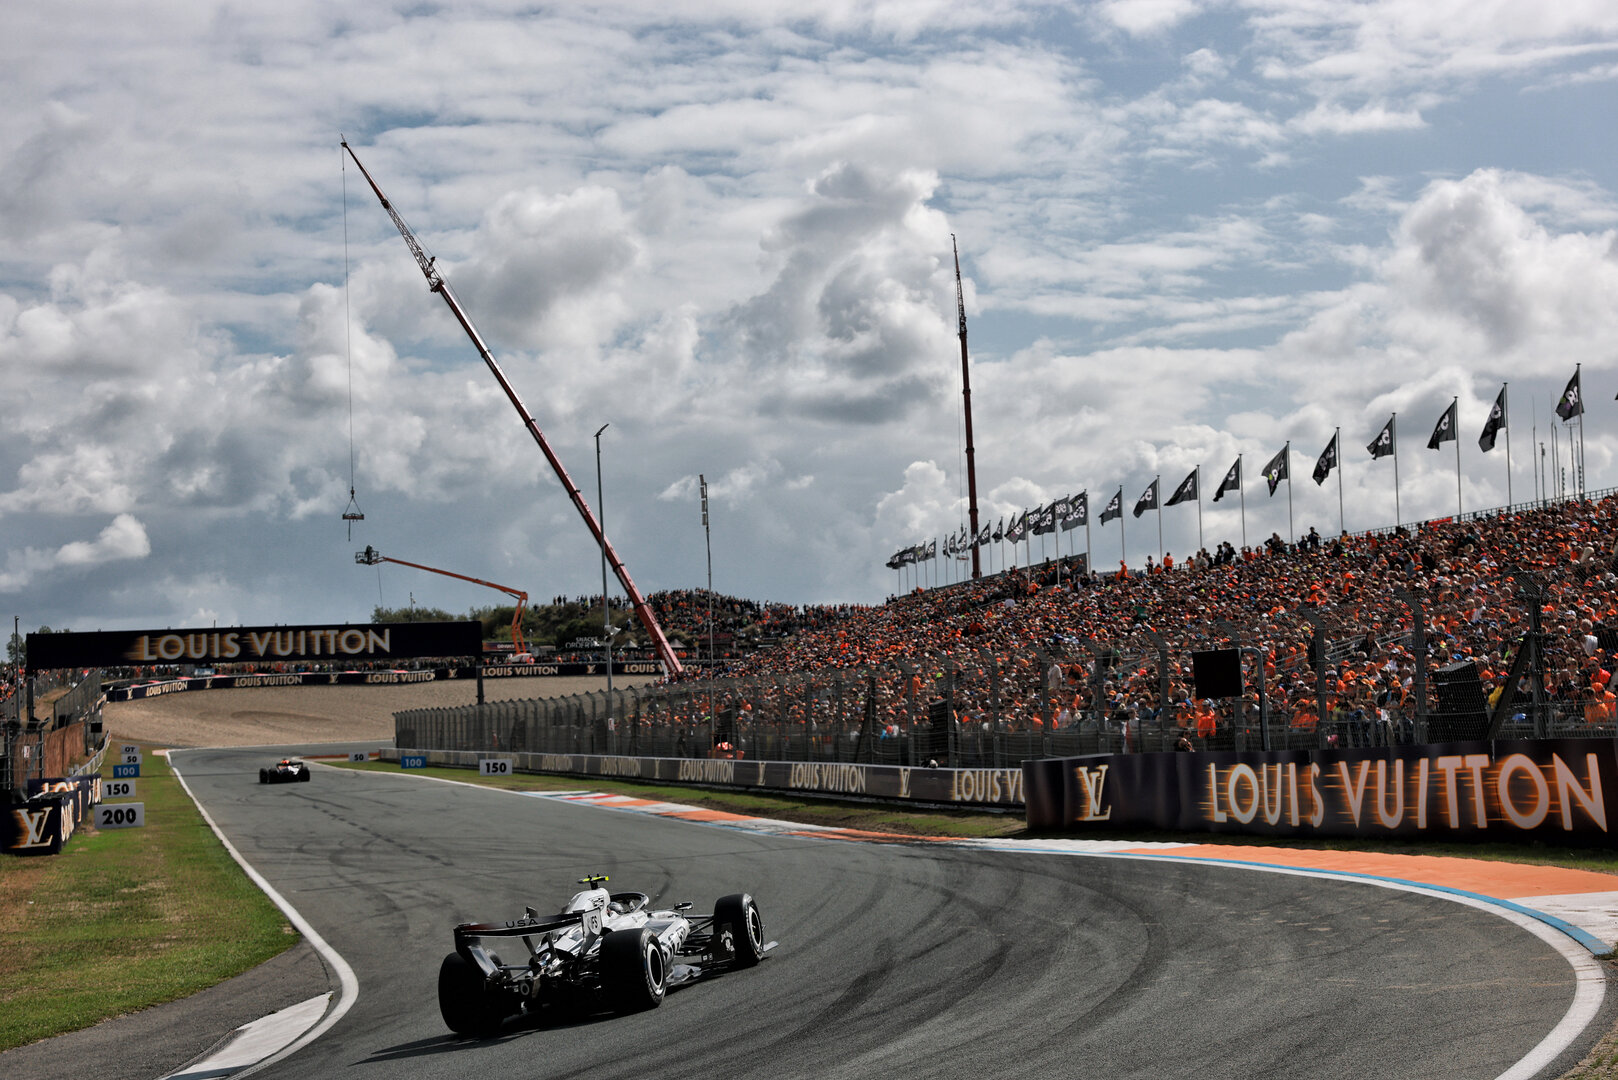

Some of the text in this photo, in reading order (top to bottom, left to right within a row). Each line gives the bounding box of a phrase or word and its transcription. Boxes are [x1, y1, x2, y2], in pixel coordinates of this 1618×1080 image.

[143, 628, 391, 661] LOUIS VUITTON
[482, 665, 558, 676] LOUIS VUITTON
[624, 664, 656, 673] LOUIS
[235, 675, 302, 688] LOUIS VUITTON
[366, 673, 399, 683] LOUIS
[146, 681, 188, 697] LOUIS VUITTON
[354, 753, 364, 761] 50
[405, 758, 422, 767] 100
[117, 767, 135, 776] 100
[485, 762, 507, 773] 150
[601, 757, 641, 777] LOUIS VUITTON
[679, 759, 734, 783] LOUIS VUITTON
[790, 761, 866, 793] LOUIS VUITTON
[106, 783, 130, 796] 150
[953, 769, 1001, 803] LOUIS
[1208, 752, 1608, 833] LOUIS VUITTON
[102, 808, 137, 825] 200
[505, 918, 539, 928] USA
